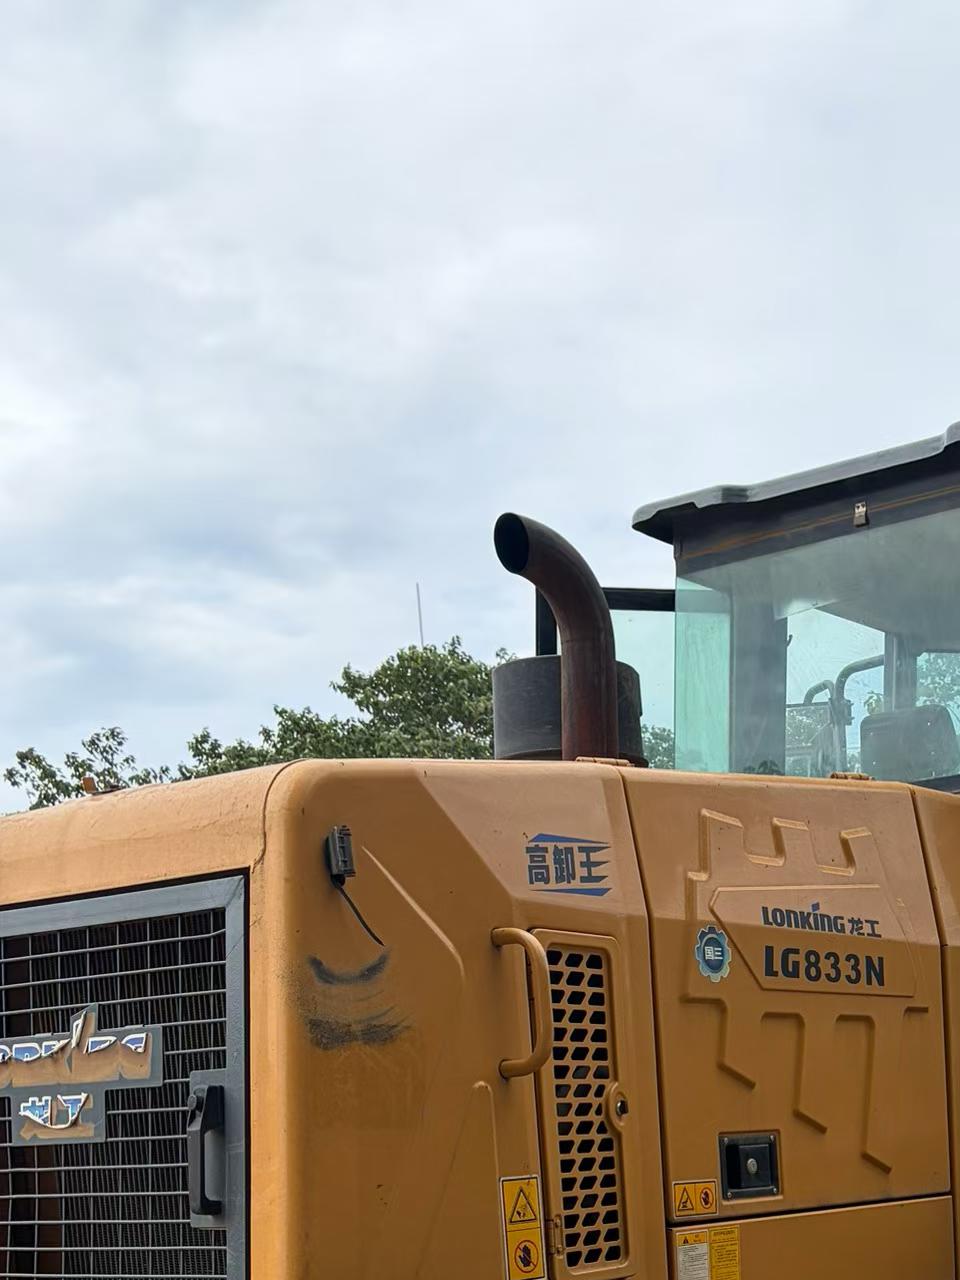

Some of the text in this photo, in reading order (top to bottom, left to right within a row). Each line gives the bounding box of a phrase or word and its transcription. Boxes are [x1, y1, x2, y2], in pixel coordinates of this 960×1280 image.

[525, 844, 612, 885] 高卸王
[847, 917, 882, 939] 龙工
[764, 945, 885, 987] LG833N
